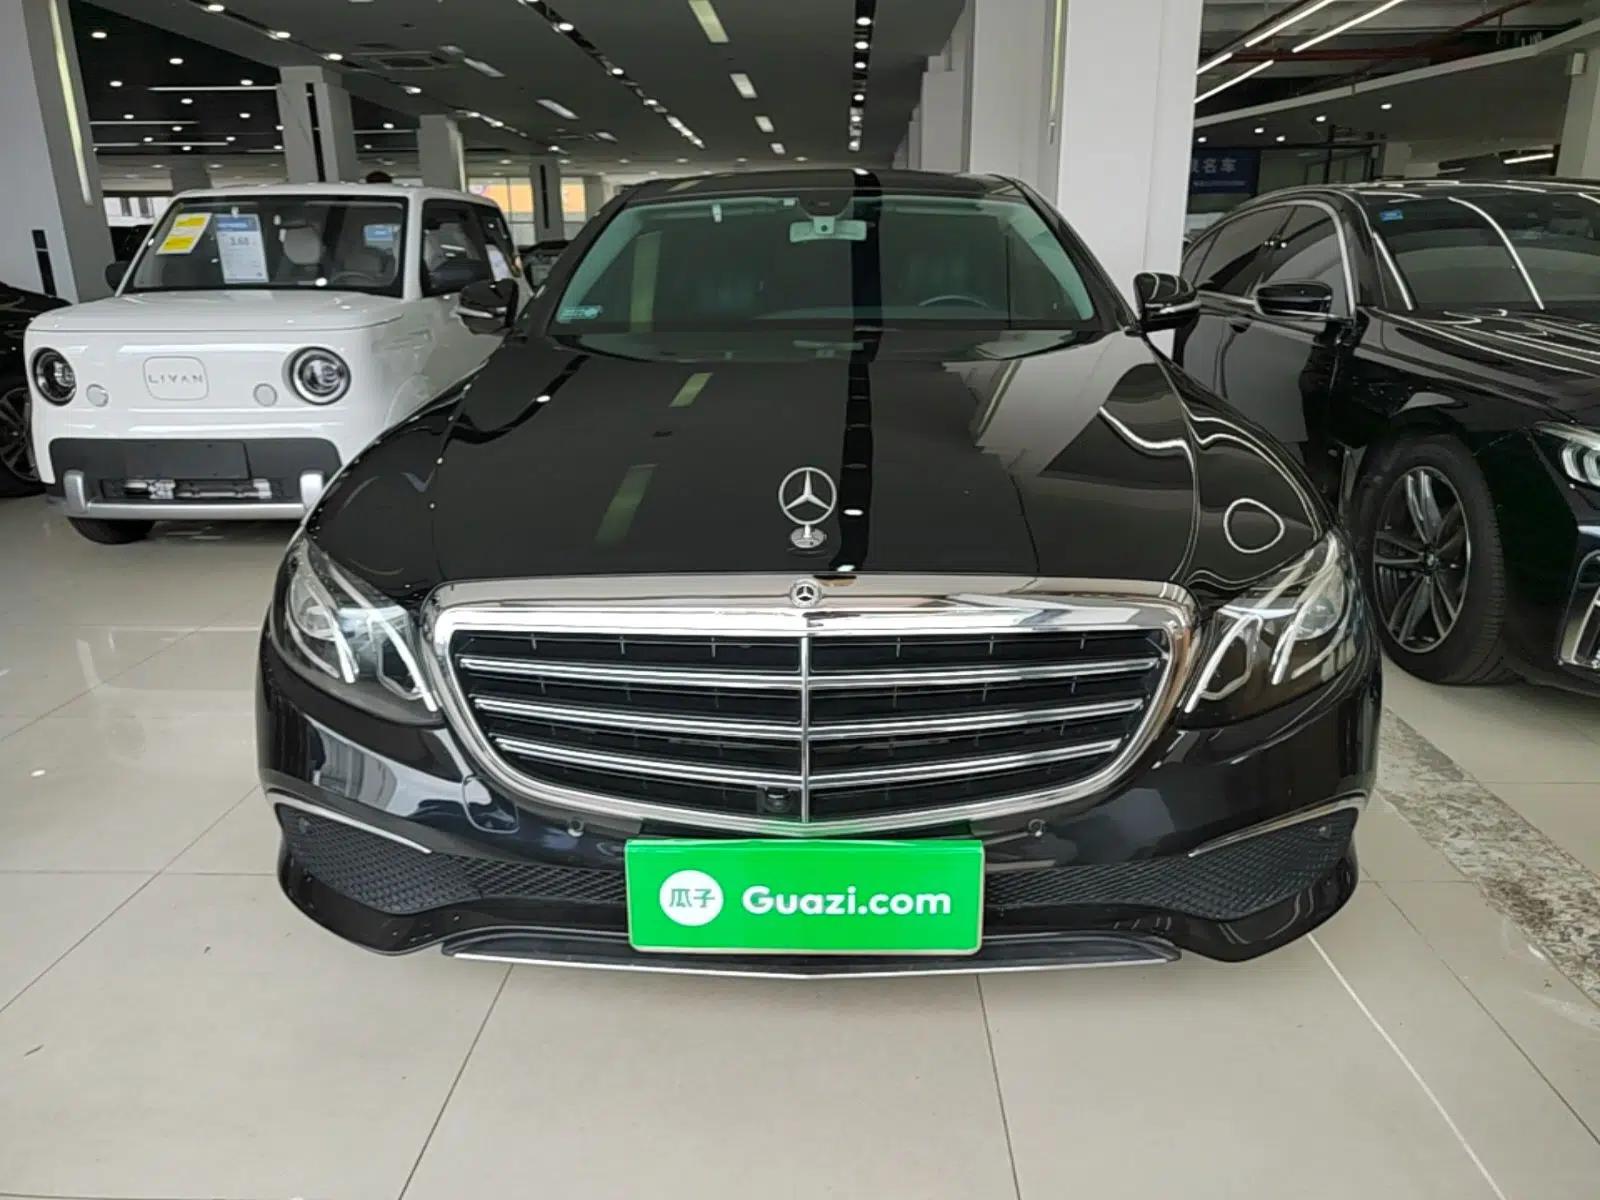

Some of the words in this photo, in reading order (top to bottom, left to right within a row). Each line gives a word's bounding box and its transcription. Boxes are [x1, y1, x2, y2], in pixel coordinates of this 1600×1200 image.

[148, 373, 203, 384] LIVAN
[669, 887, 716, 909] 瓜子
[742, 885, 951, 915] Guazi.com
